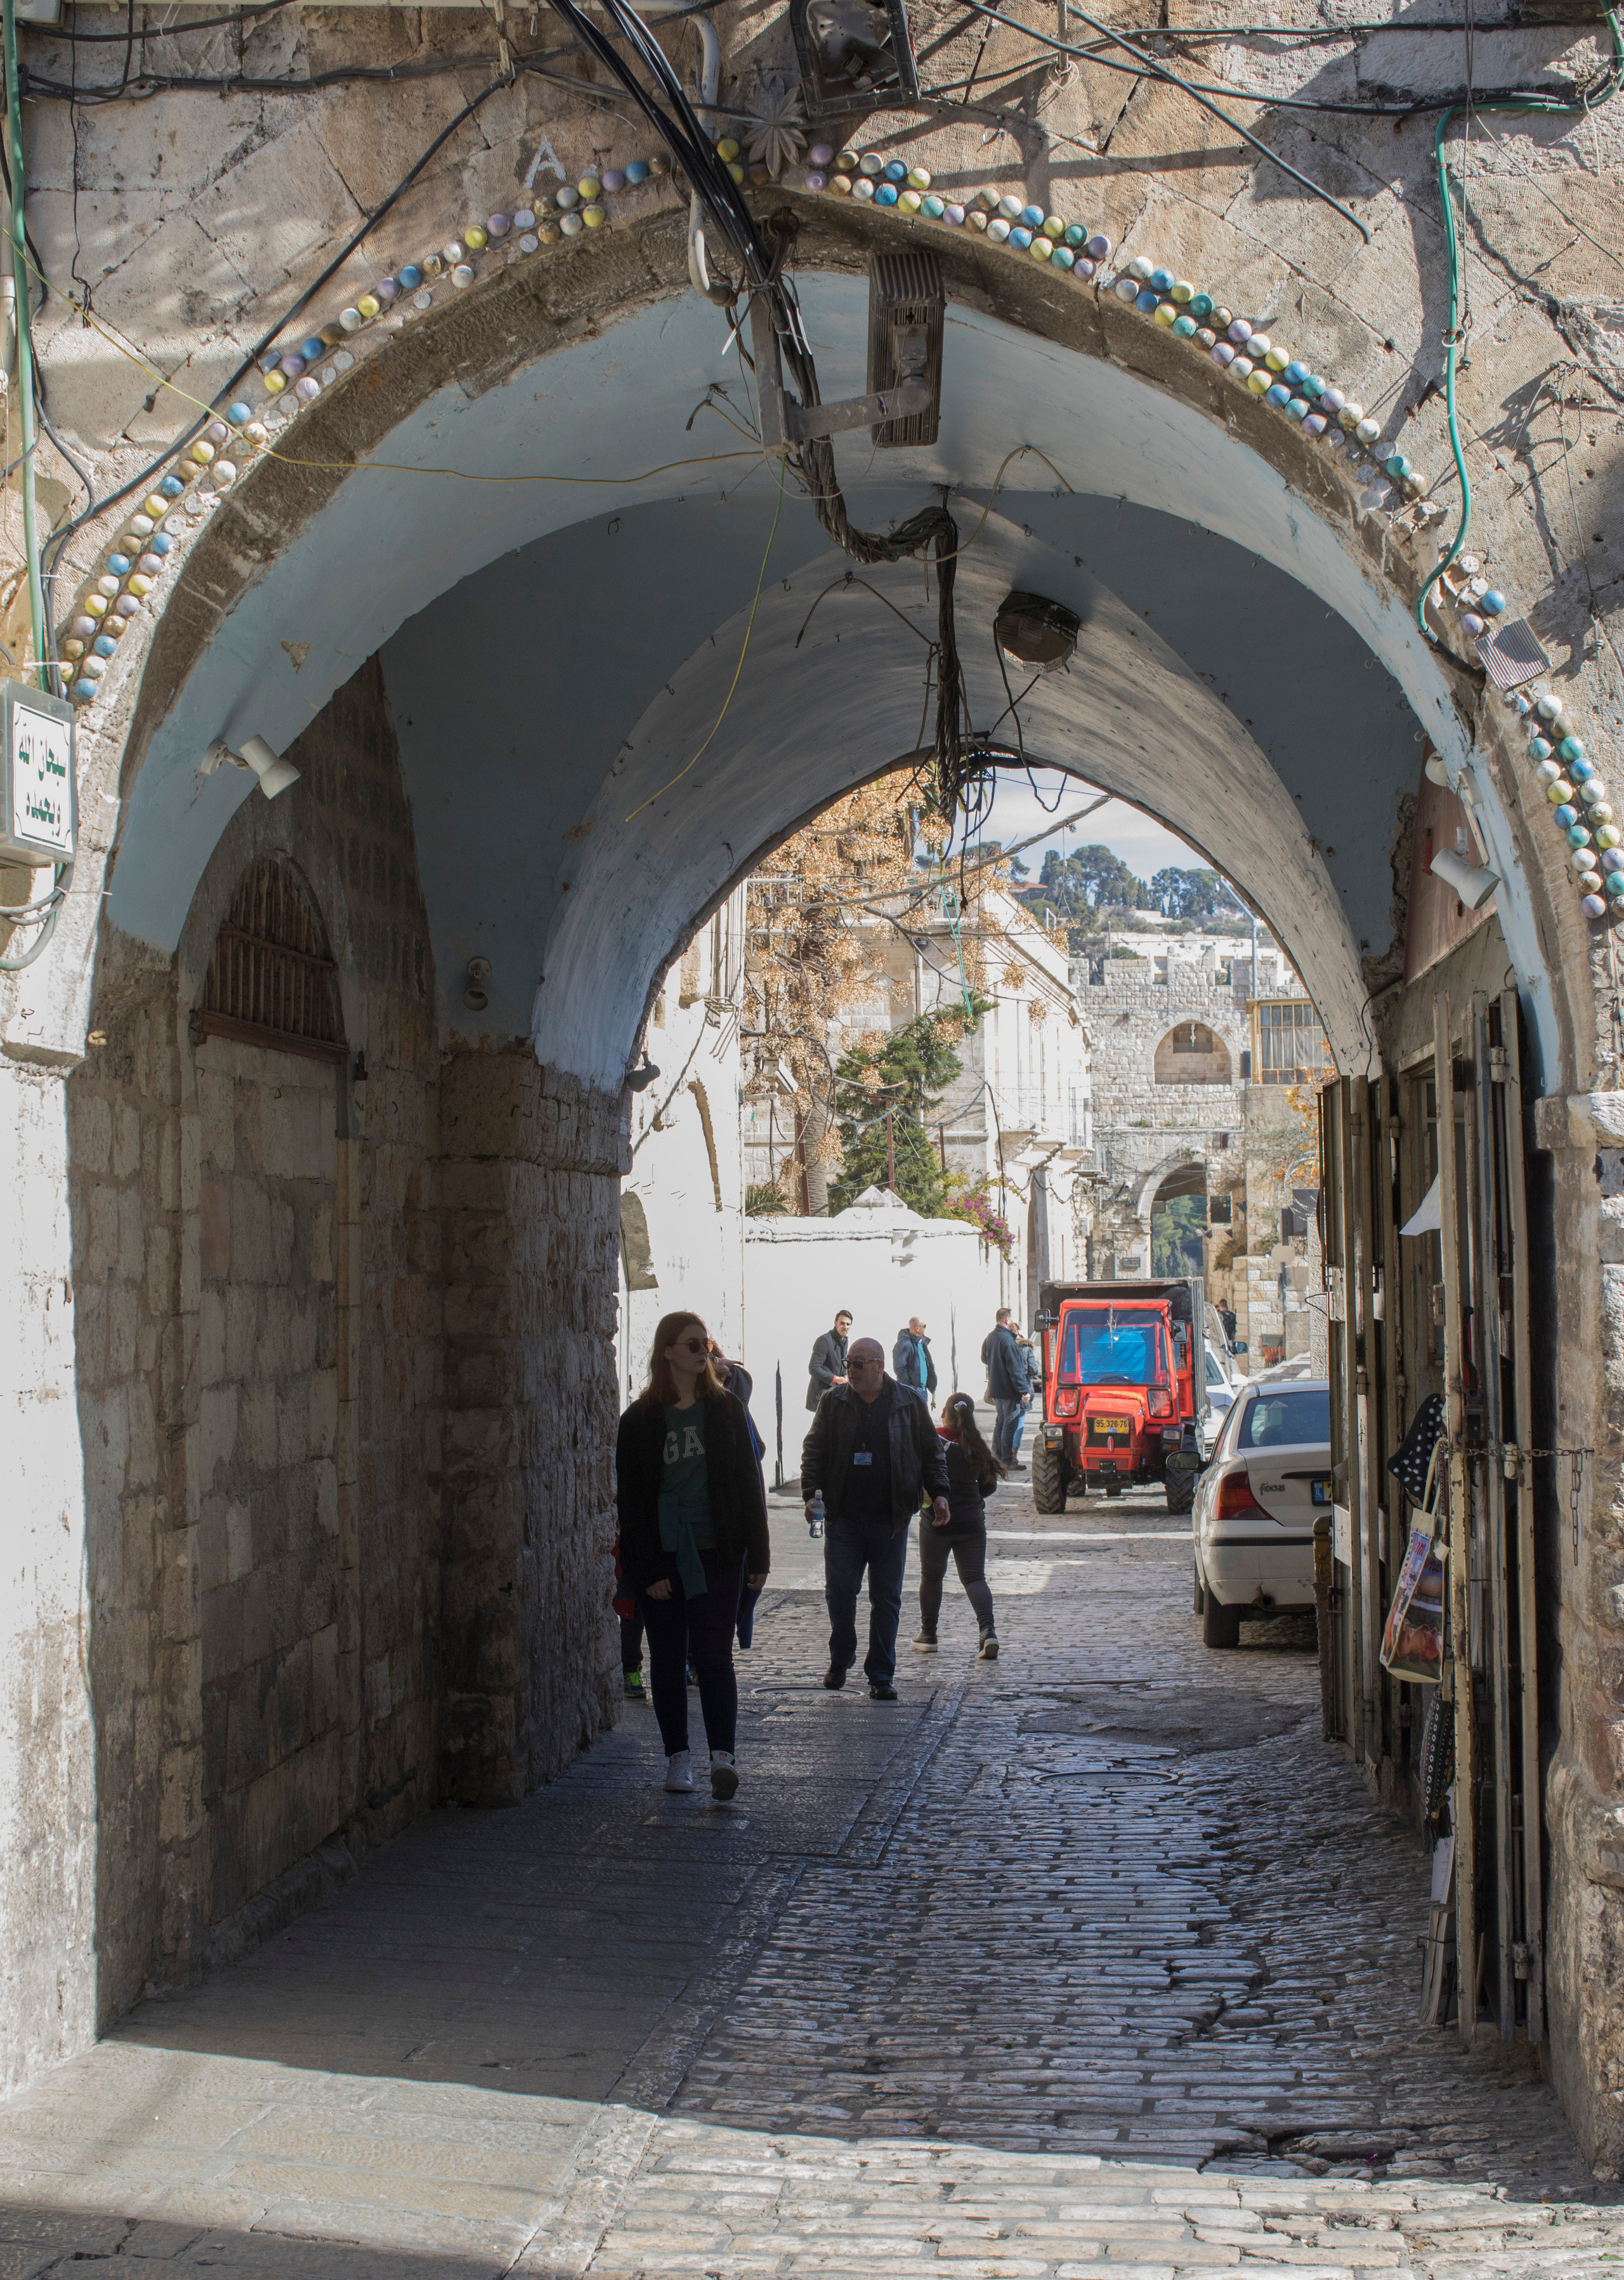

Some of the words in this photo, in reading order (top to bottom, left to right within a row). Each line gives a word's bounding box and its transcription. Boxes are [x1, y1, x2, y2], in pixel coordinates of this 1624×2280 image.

[523, 134, 566, 189] A
[18, 722, 34, 765] الله
[38, 738, 66, 787] سبحان
[26, 791, 60, 837] وبحمده
